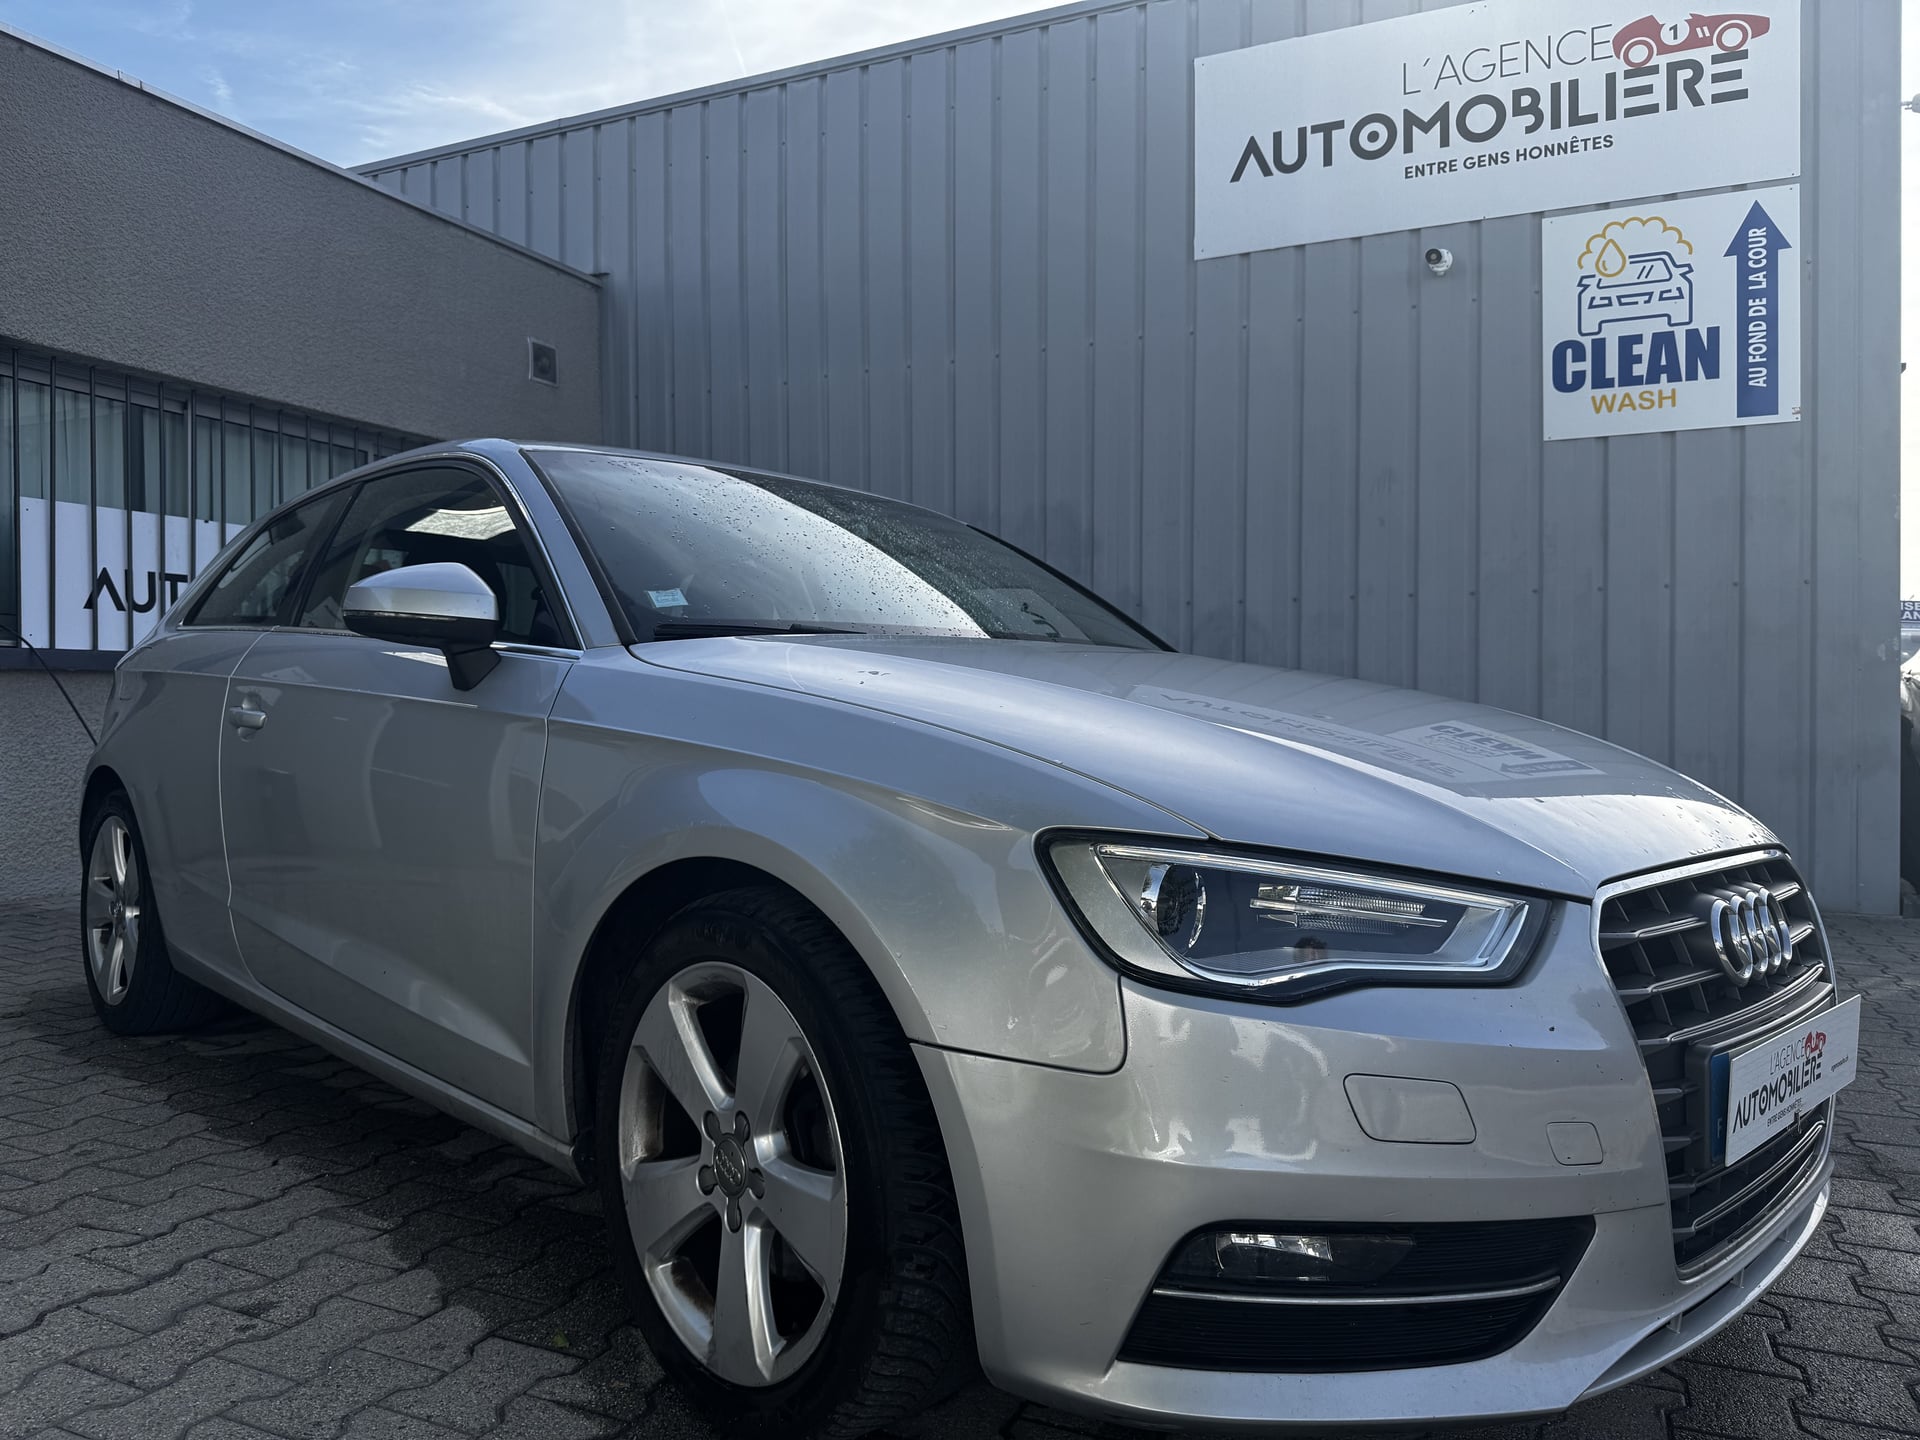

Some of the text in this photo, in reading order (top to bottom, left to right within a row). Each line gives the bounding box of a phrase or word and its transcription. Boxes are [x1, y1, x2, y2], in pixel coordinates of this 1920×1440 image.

[1668, 23, 1679, 41] 1
[1404, 135, 1614, 179] ENTRE GENS HONNÊTES
[1748, 226, 1768, 387] AU FOND DE LA COUR
[1552, 325, 1720, 393] CLEAN
[1591, 388, 1677, 414] WASH
